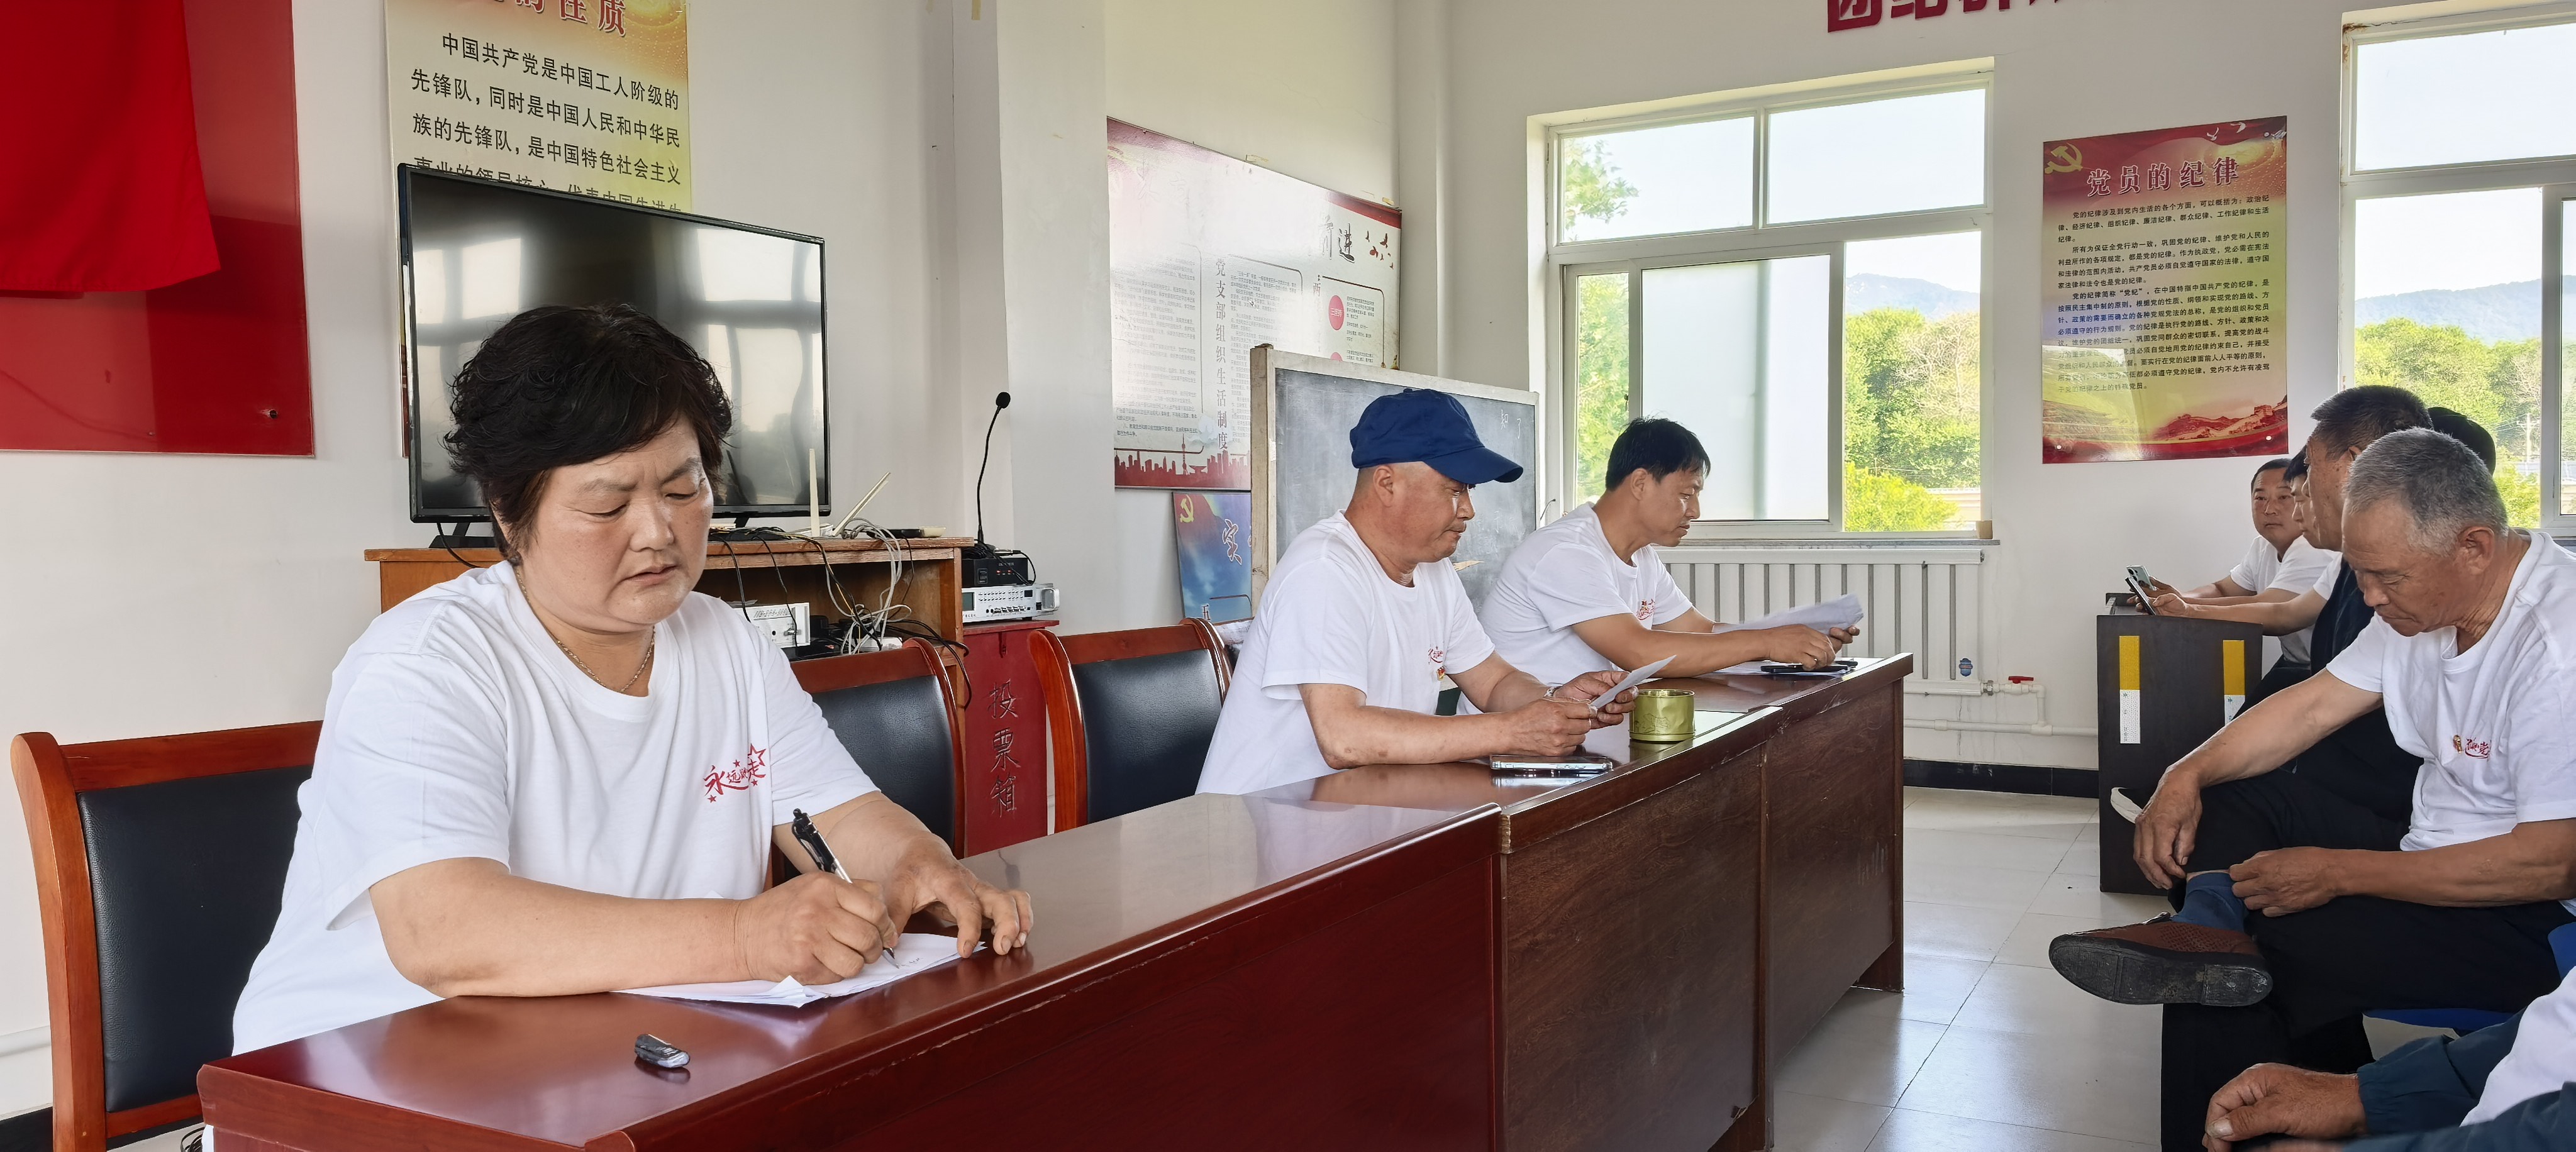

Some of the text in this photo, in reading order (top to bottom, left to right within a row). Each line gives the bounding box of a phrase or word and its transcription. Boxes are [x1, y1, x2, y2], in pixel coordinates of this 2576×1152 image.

[411, 69, 680, 148] 先锋队，同时是中国人民和中华民
[443, 33, 678, 111] 中国共产党是中国工人阶级的
[413, 113, 680, 185] 族的先锋队，是中国特色社会主义
[2087, 157, 2239, 196] 党员的纪律
[2058, 277, 2146, 289] 家法律和法令也是党的纪律。
[1215, 258, 1228, 450] 党支部组织生活制度
[988, 678, 1021, 818] 投票箱
